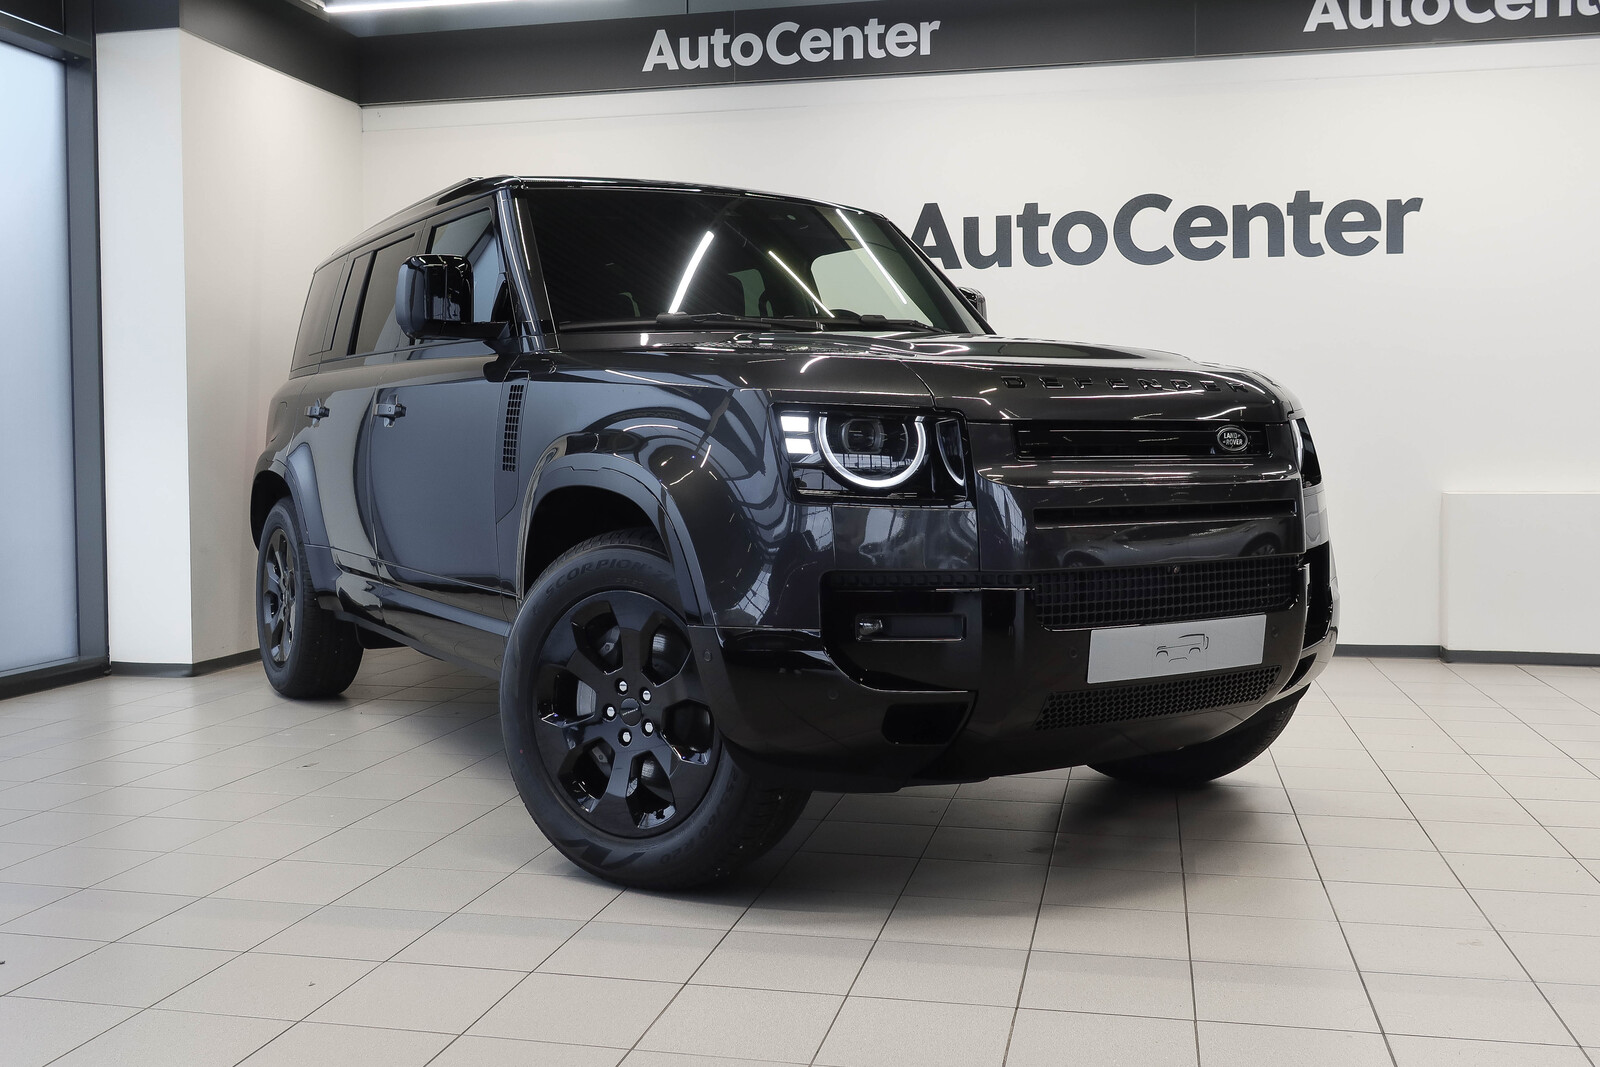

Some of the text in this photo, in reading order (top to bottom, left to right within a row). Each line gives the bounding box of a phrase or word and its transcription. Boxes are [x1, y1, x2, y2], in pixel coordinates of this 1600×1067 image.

[641, 18, 941, 72] AutoCenter
[909, 190, 1424, 270] AutoCenter
[1001, 375, 1248, 393] DEFENDER
[545, 558, 647, 597] SCORPION
